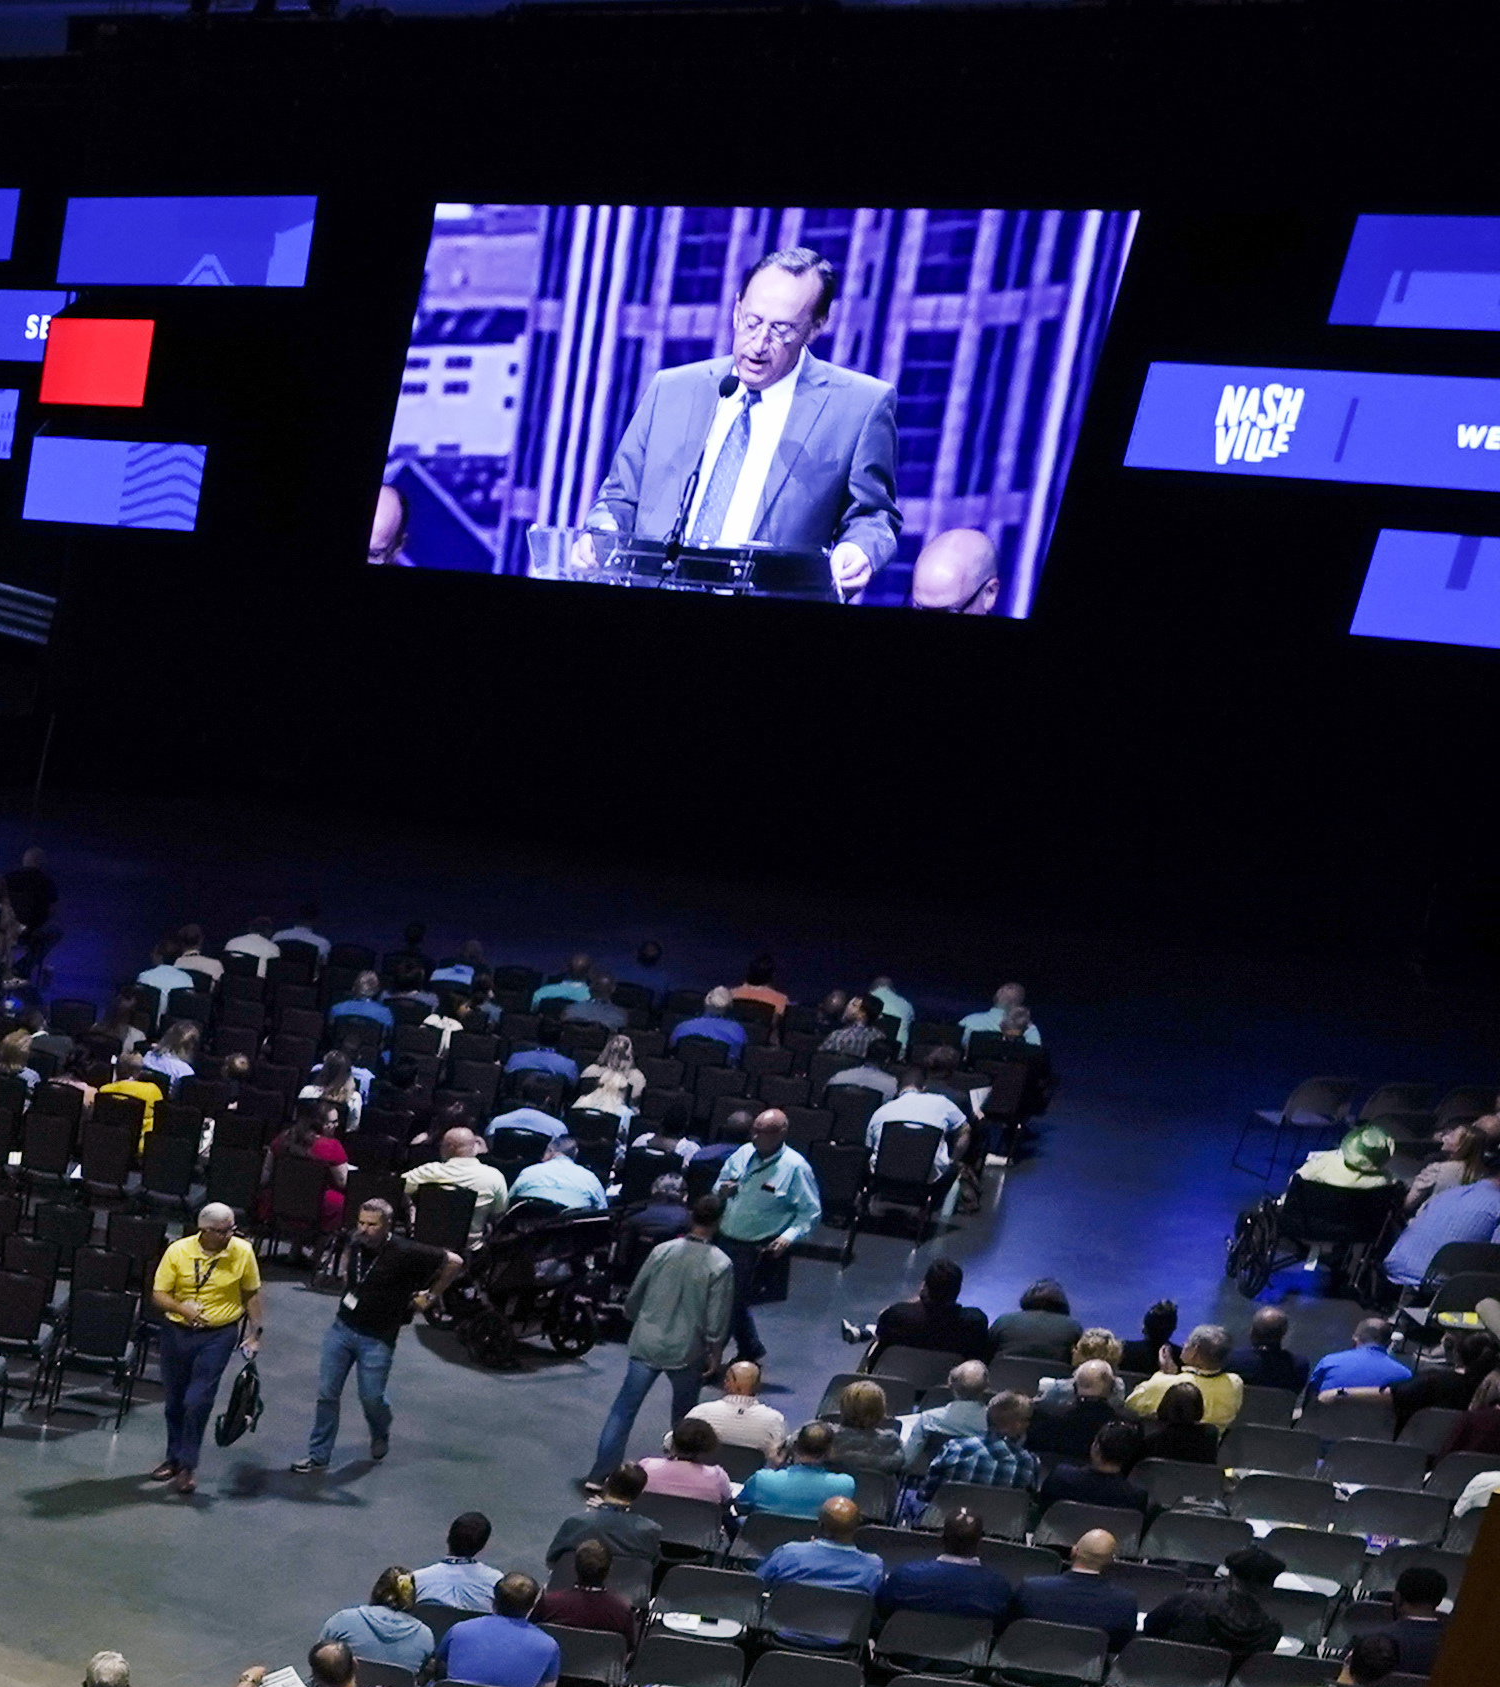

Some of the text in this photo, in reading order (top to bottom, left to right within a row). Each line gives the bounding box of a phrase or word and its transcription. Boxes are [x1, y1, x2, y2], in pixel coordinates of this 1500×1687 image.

[1215, 383, 1305, 430] NASH
[1215, 420, 1296, 465] VILLE
[1457, 423, 1500, 451] WE
